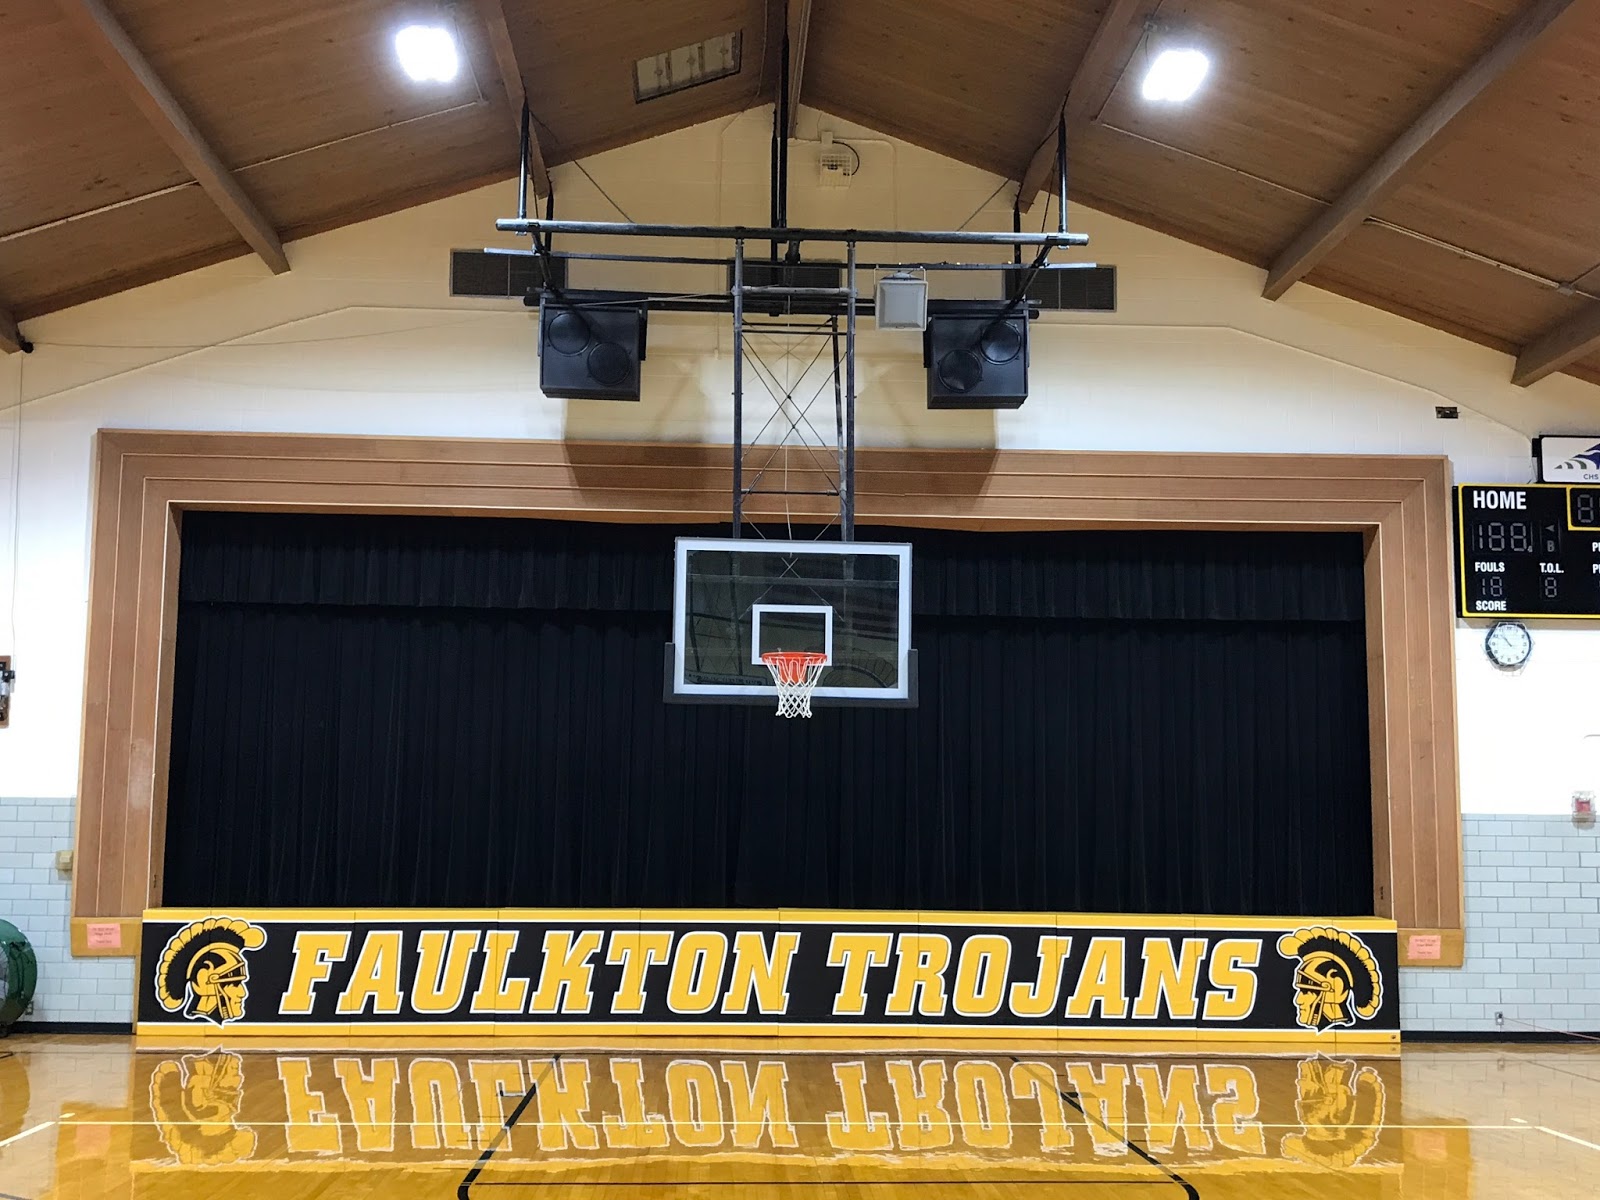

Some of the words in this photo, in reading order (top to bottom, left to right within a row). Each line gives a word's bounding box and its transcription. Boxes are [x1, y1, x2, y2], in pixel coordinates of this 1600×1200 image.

[1473, 490, 1527, 510] HOME
[1474, 562, 1505, 573] FOULS
[1539, 562, 1565, 574] T.O.L.
[1475, 600, 1507, 611] SCORE
[277, 929, 802, 1017] FAULKTON
[825, 932, 1263, 1022] TROJANS
